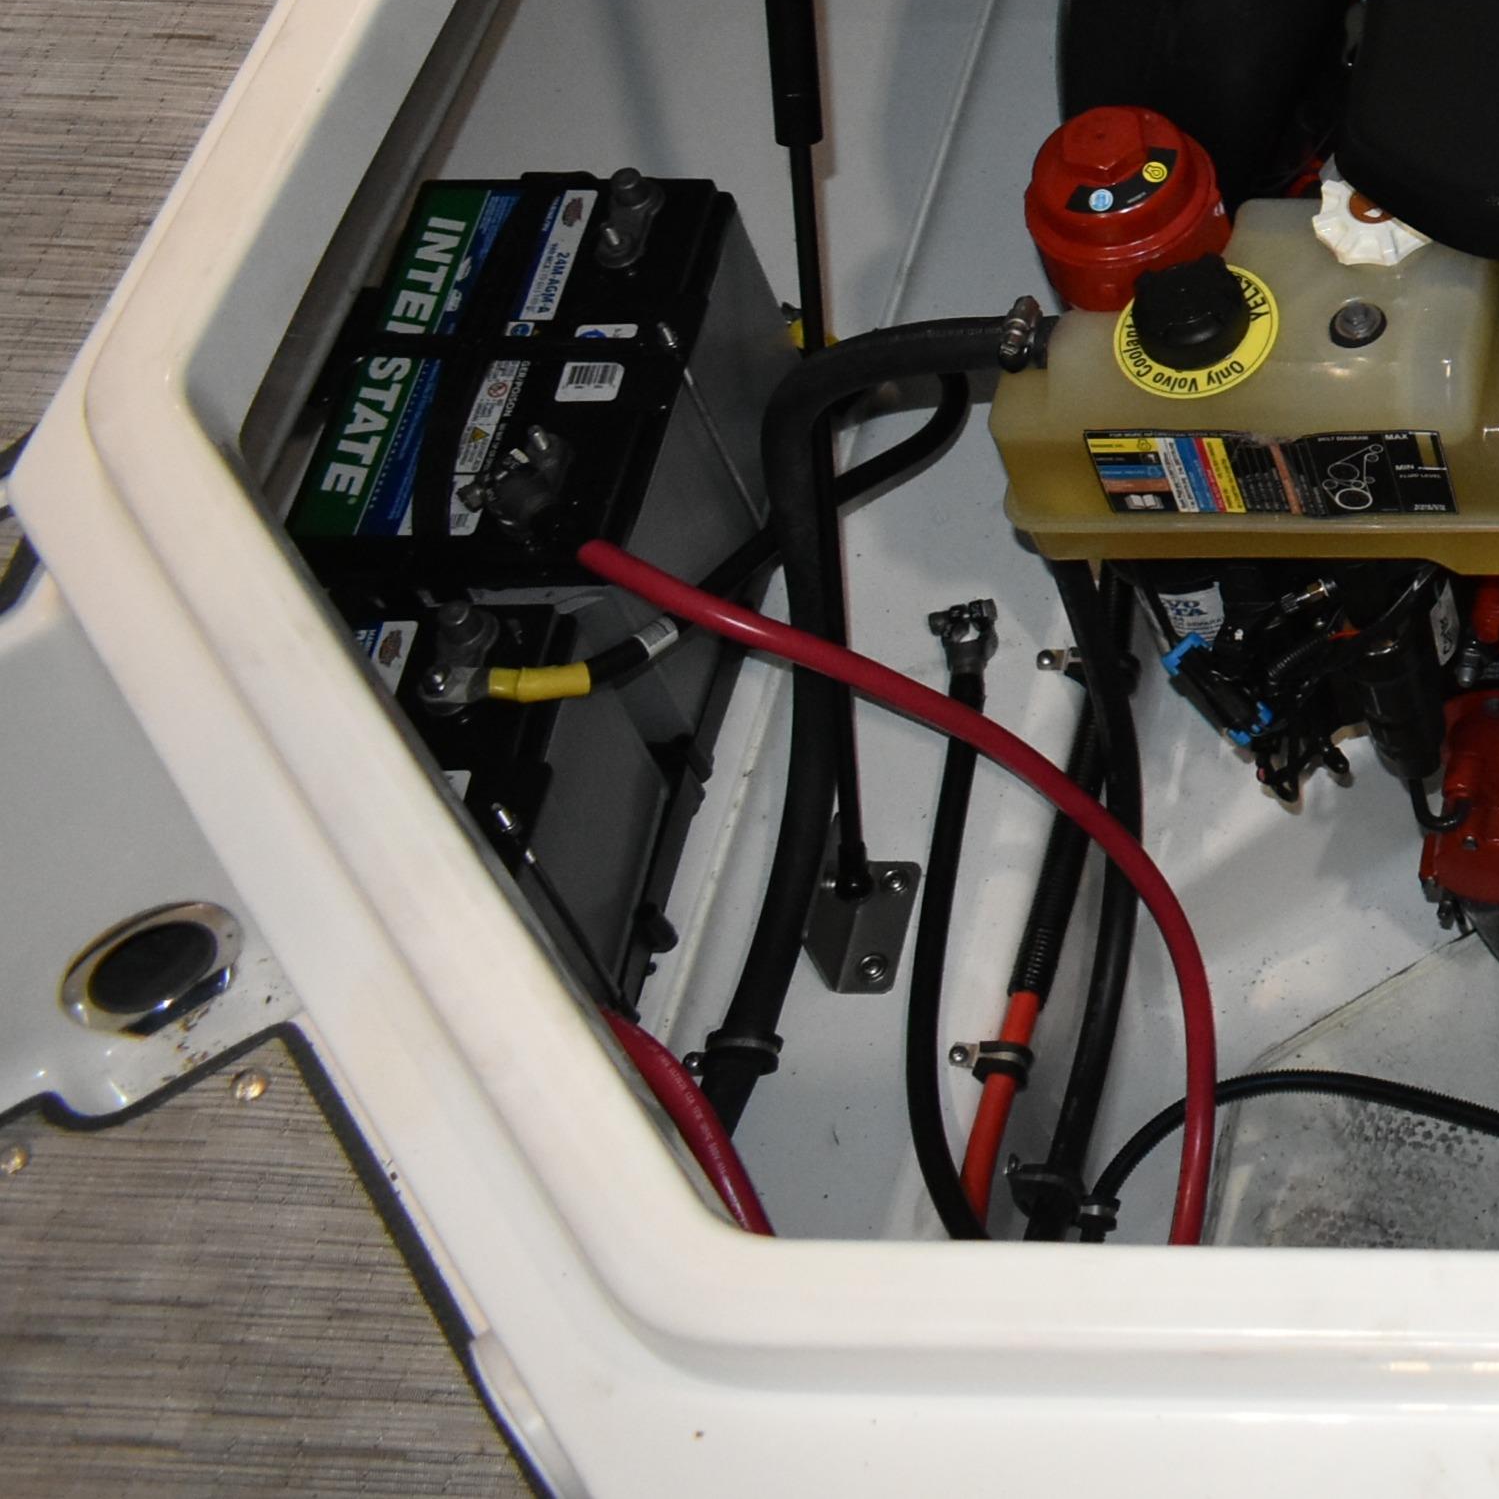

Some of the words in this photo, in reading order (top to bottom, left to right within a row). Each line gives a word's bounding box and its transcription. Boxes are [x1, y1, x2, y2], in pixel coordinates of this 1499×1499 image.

[1236, 275, 1269, 321] YELL
[321, 215, 467, 498] INTESTATE
[1206, 360, 1244, 384] Only
[503, 359, 531, 418] GER/POISON
[1153, 372, 1198, 391] Volvo
